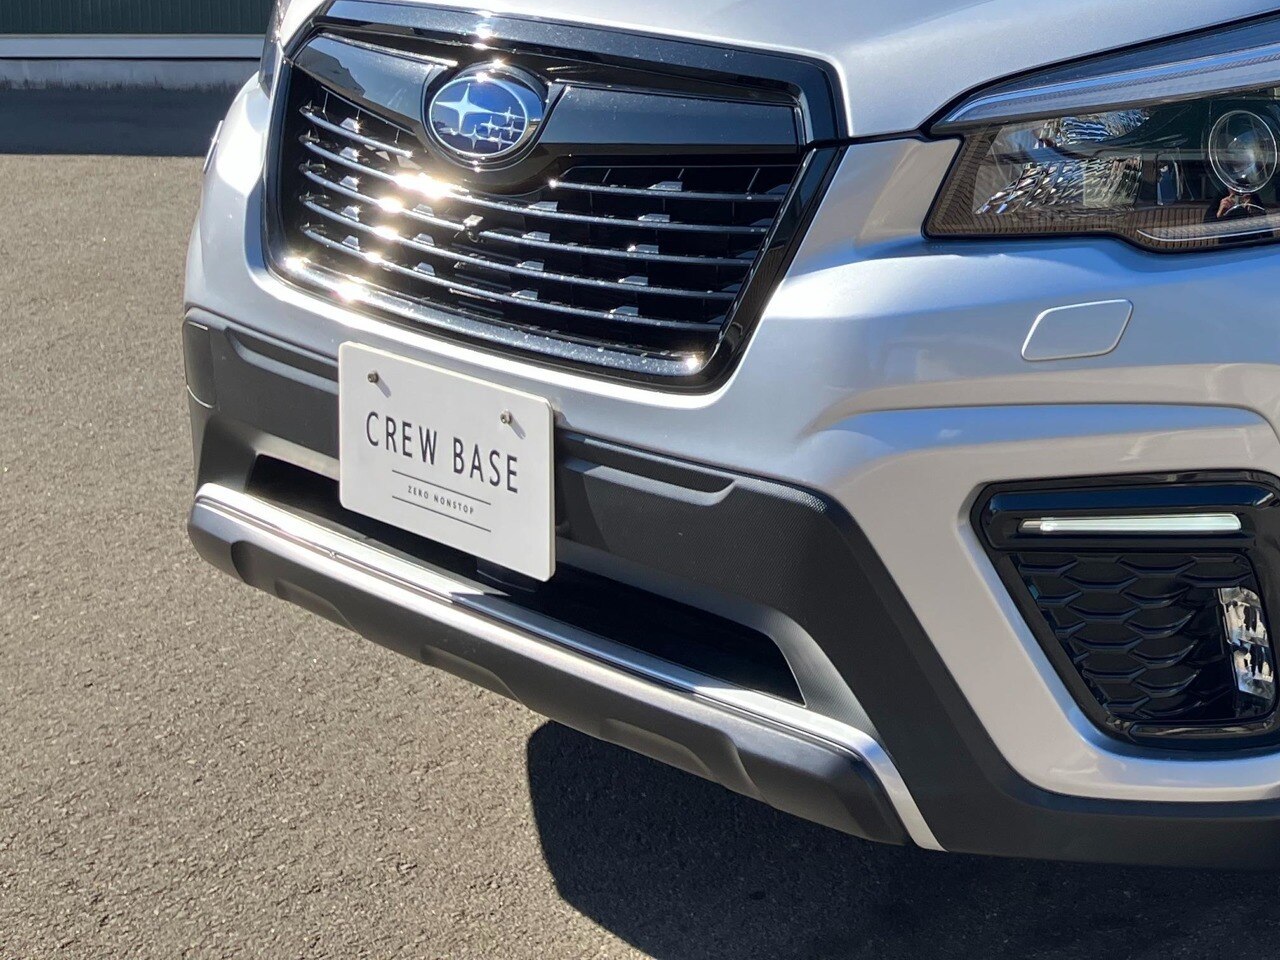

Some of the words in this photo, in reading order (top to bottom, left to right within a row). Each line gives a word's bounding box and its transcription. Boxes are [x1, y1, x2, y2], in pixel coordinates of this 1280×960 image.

[366, 412, 437, 465] CREW
[452, 437, 519, 493] BASE
[407, 485, 429, 500] ZERO
[433, 494, 475, 515] NONSTOP
